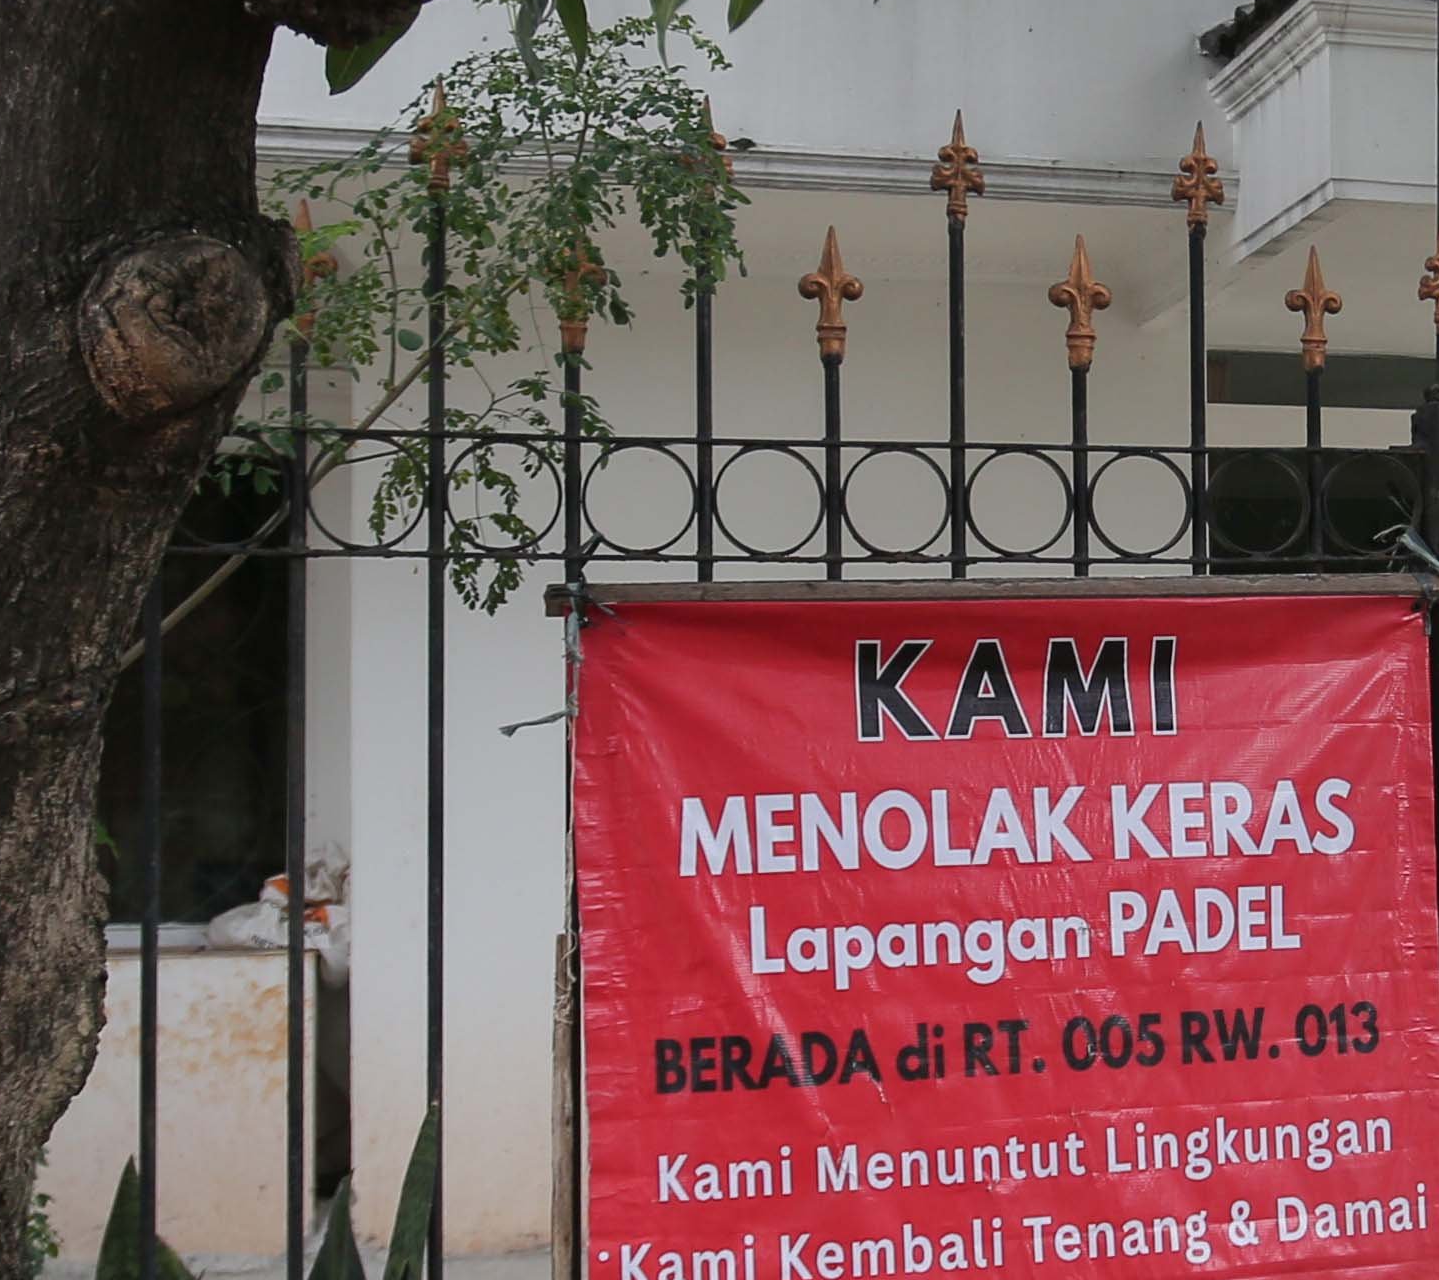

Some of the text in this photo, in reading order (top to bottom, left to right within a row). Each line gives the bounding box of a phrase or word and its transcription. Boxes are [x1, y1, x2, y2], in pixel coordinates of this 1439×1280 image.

[855, 635, 1177, 743] KAMI
[678, 778, 1356, 877] MENOLAK KERAS
[750, 886, 1300, 991] Lapangan PADEL
[655, 1000, 1380, 1095] BERADA di RT. 005 RW. 013
[657, 1115, 1393, 1203] Kami Menuntut Lingkungan
[1023, 1209, 1209, 1266] Tenang
[1230, 1200, 1259, 1247] &
[1277, 1184, 1430, 1244] Damai
